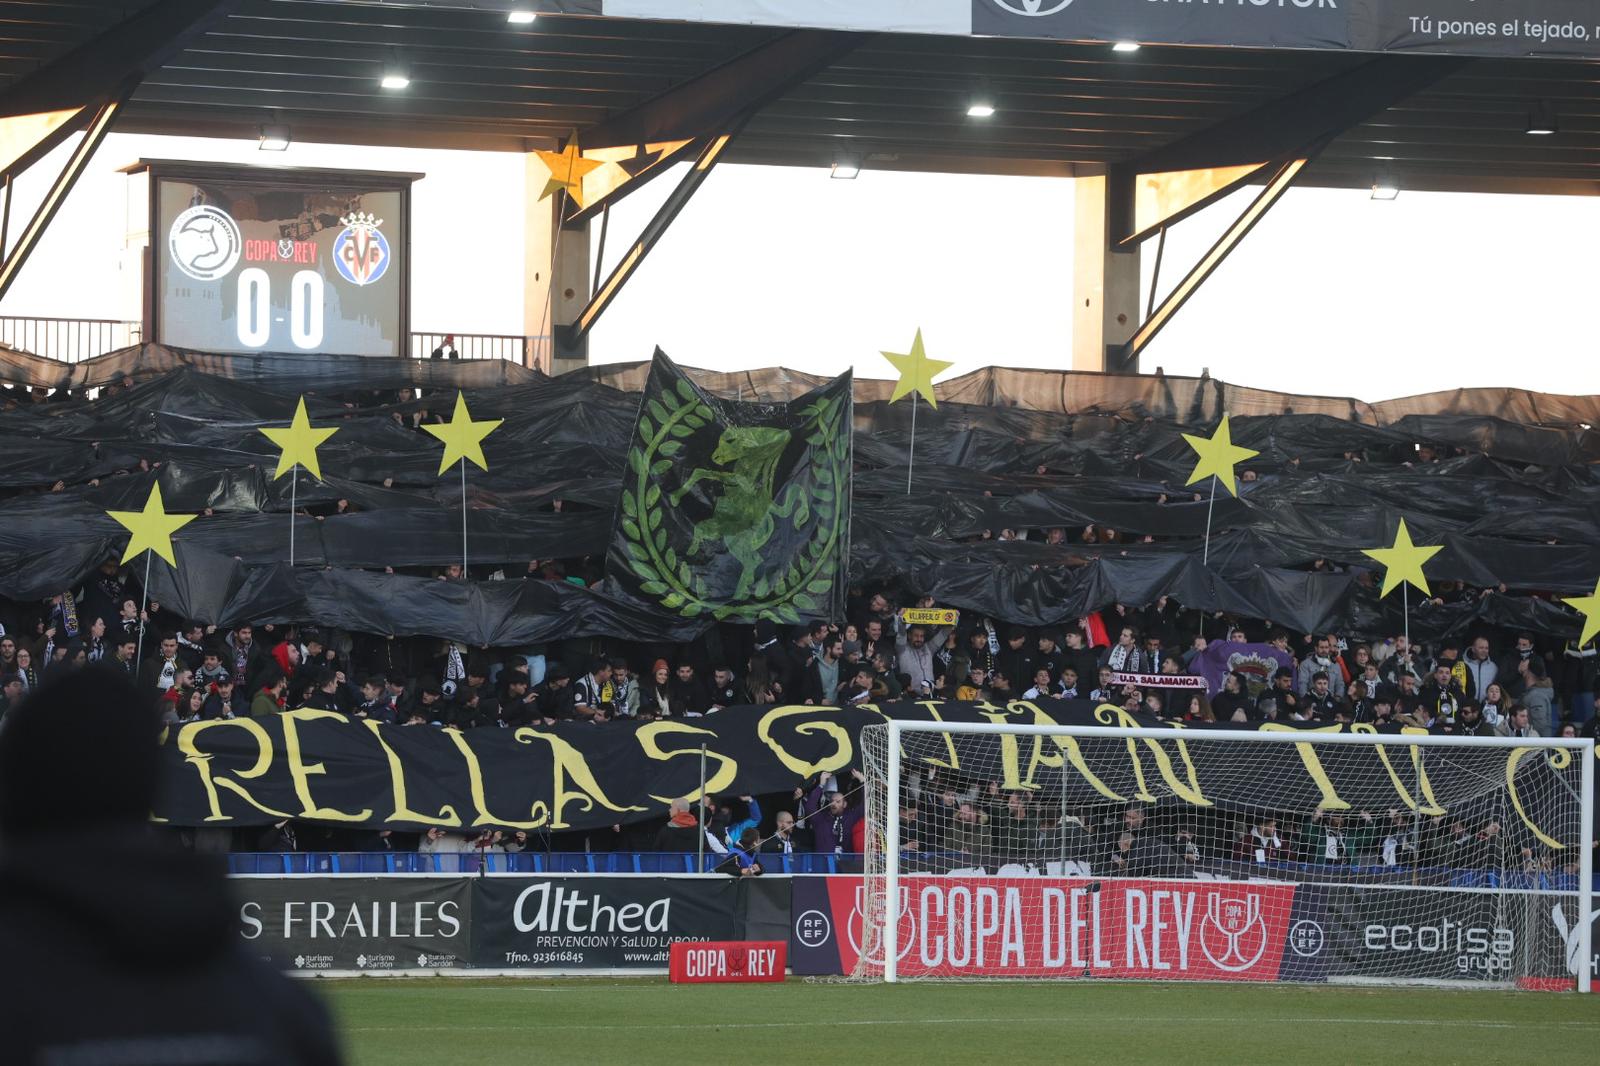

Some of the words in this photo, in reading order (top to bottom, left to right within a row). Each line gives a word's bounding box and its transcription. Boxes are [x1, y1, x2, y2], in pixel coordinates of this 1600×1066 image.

[1409, 16, 1431, 33] Tú
[1437, 20, 1497, 39] pones
[1502, 20, 1518, 36] el
[1524, 20, 1590, 42] tejado,
[245, 239, 277, 261] COPA
[294, 241, 317, 263] REY
[237, 267, 270, 347] 0
[291, 269, 324, 349] 0
[1120, 674, 1138, 683] U.D.
[1140, 676, 1199, 686] SALAMANCA
[150, 706, 737, 829] RELLAS
[284, 900, 460, 938] FRAILES
[920, 886, 1024, 968] COPA
[1043, 888, 1112, 968] DEL
[1126, 889, 1195, 970] REY
[537, 936, 609, 947] PREVENCION
[611, 936, 619, 947] Y
[506, 953, 530, 963] Tfno.
[533, 953, 584, 964] 923616845
[687, 949, 726, 977] COPA
[748, 949, 776, 976] REY
[1457, 956, 1512, 975] grupo
